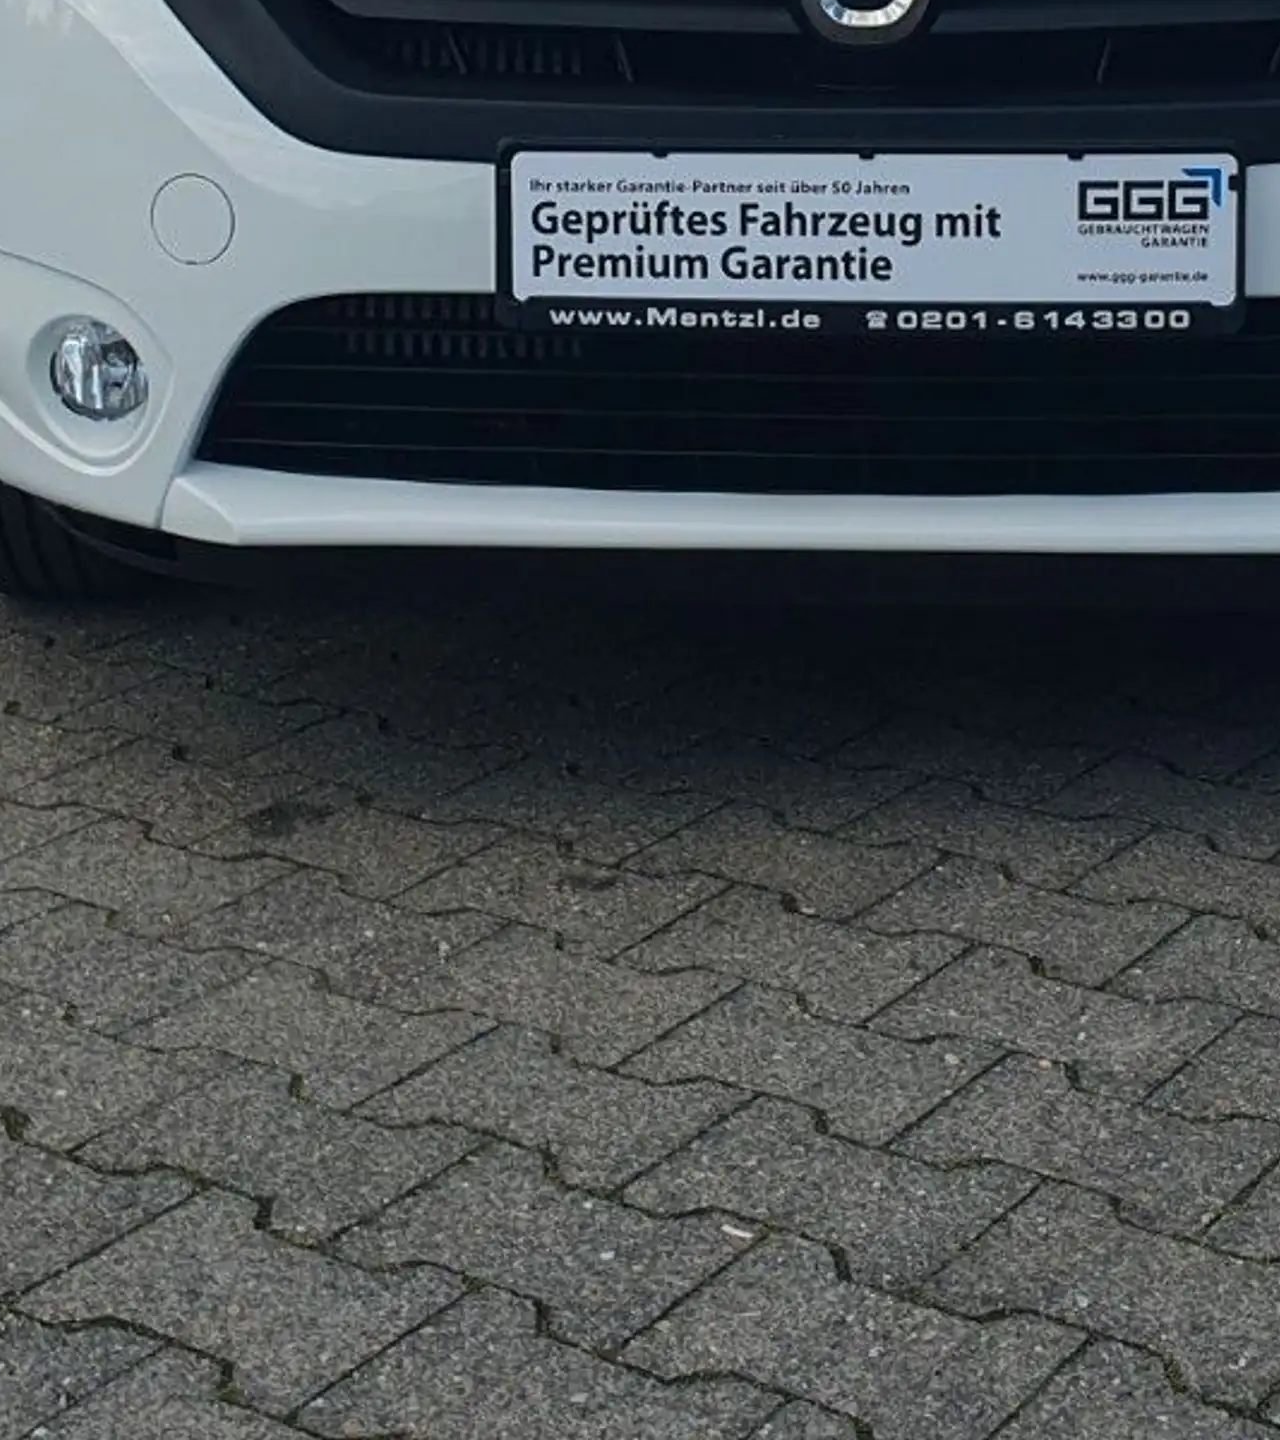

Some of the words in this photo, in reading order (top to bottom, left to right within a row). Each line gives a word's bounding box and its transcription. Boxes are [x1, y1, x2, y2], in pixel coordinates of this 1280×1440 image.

[528, 178, 554, 194] Ihr
[556, 179, 612, 194] starker
[756, 180, 786, 195] seit
[790, 180, 827, 195] über
[831, 181, 851, 195] 50
[855, 180, 911, 196] Jahren
[1078, 180, 1210, 221] GGG
[531, 200, 727, 244] Geprüftes
[740, 201, 923, 247] Fahrzeug
[934, 203, 1002, 239] mit
[1077, 223, 1210, 237] GEBRAUCHTWAGEN
[1140, 236, 1209, 249] GARANTIE
[532, 244, 709, 279] Premium
[721, 245, 894, 281] Garantie
[549, 306, 822, 329] www.Mentzl.de
